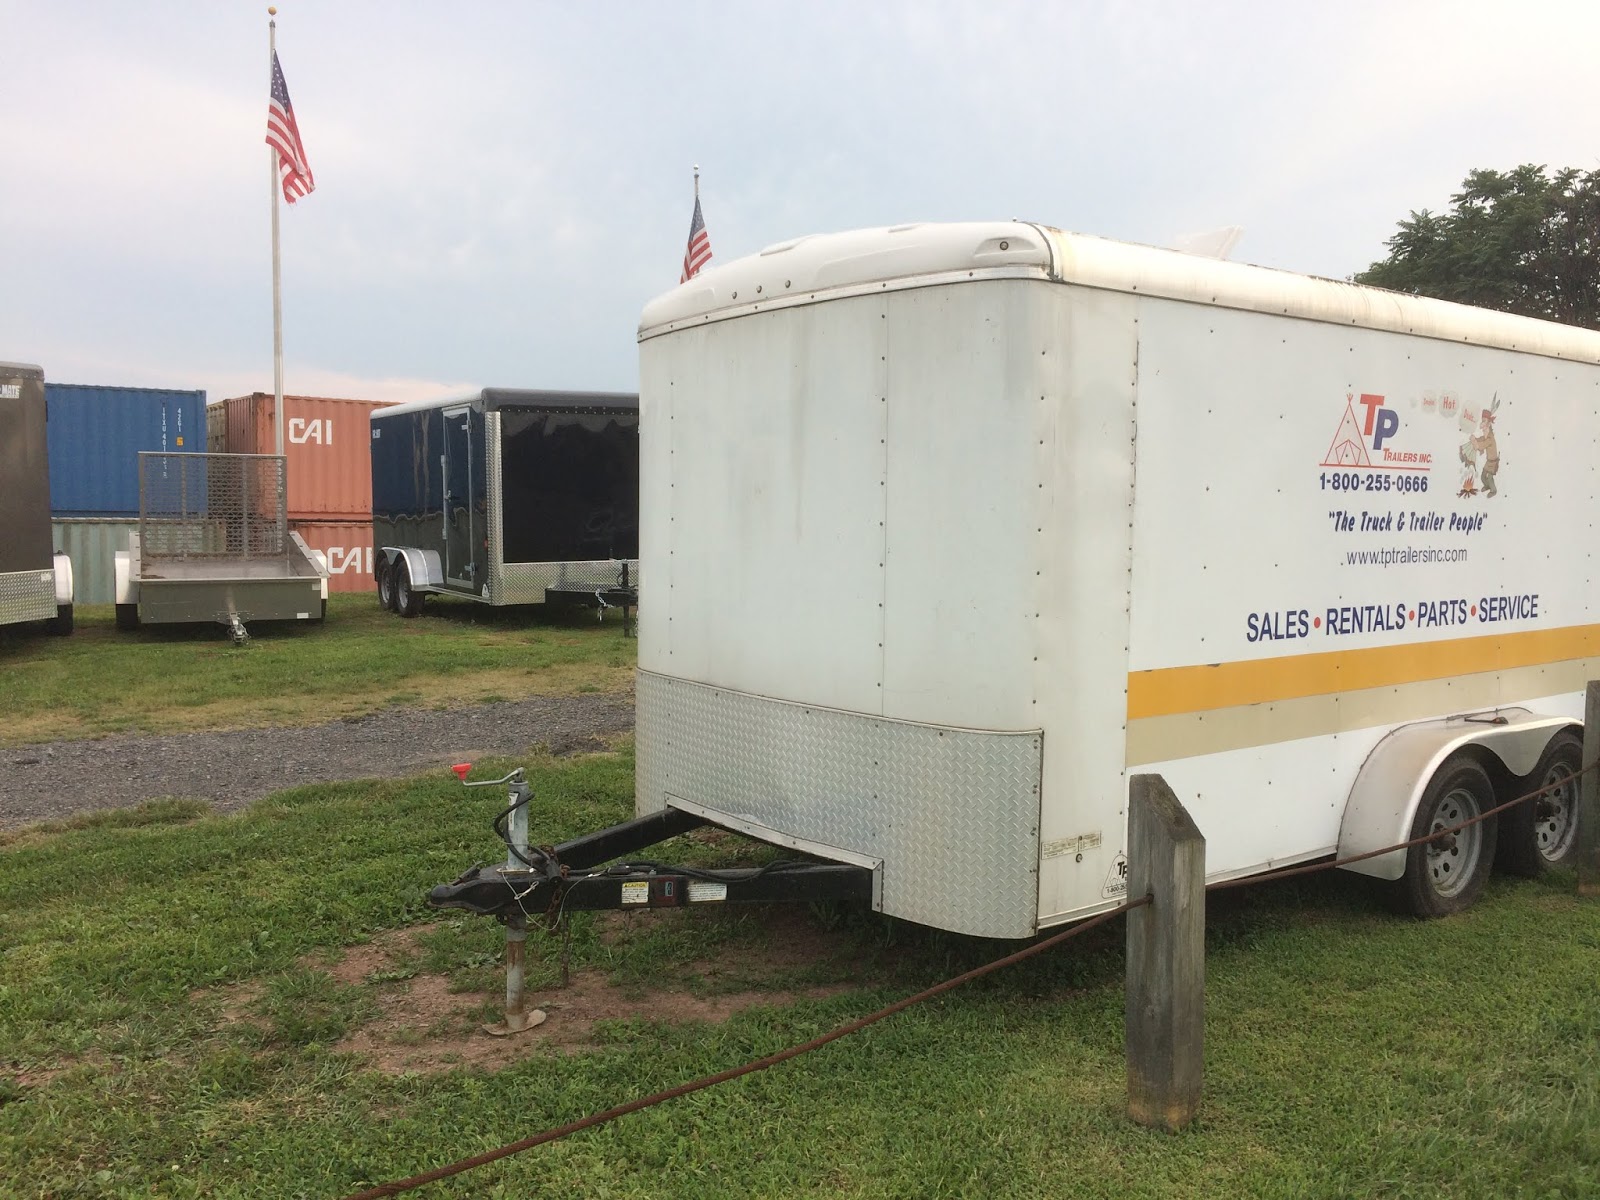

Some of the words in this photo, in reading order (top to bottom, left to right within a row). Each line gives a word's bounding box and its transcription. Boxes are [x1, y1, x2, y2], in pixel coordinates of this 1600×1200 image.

[1443, 396, 1456, 409] Hot
[288, 418, 332, 445] CAI
[1360, 393, 1399, 450] TP
[1319, 472, 1429, 493] 1-800-255-0666
[1360, 510, 1393, 532] Truck
[1396, 511, 1405, 532] &
[1409, 511, 1445, 532] Trailer
[1449, 512, 1488, 536] People"
[326, 546, 374, 574] CAI
[1346, 545, 1468, 568] www.tptrailersinc.com
[1246, 609, 1310, 642] SALES
[1325, 603, 1407, 636] RENTALS
[1417, 598, 1468, 628] PARTS
[1478, 594, 1540, 623] SERVICE
